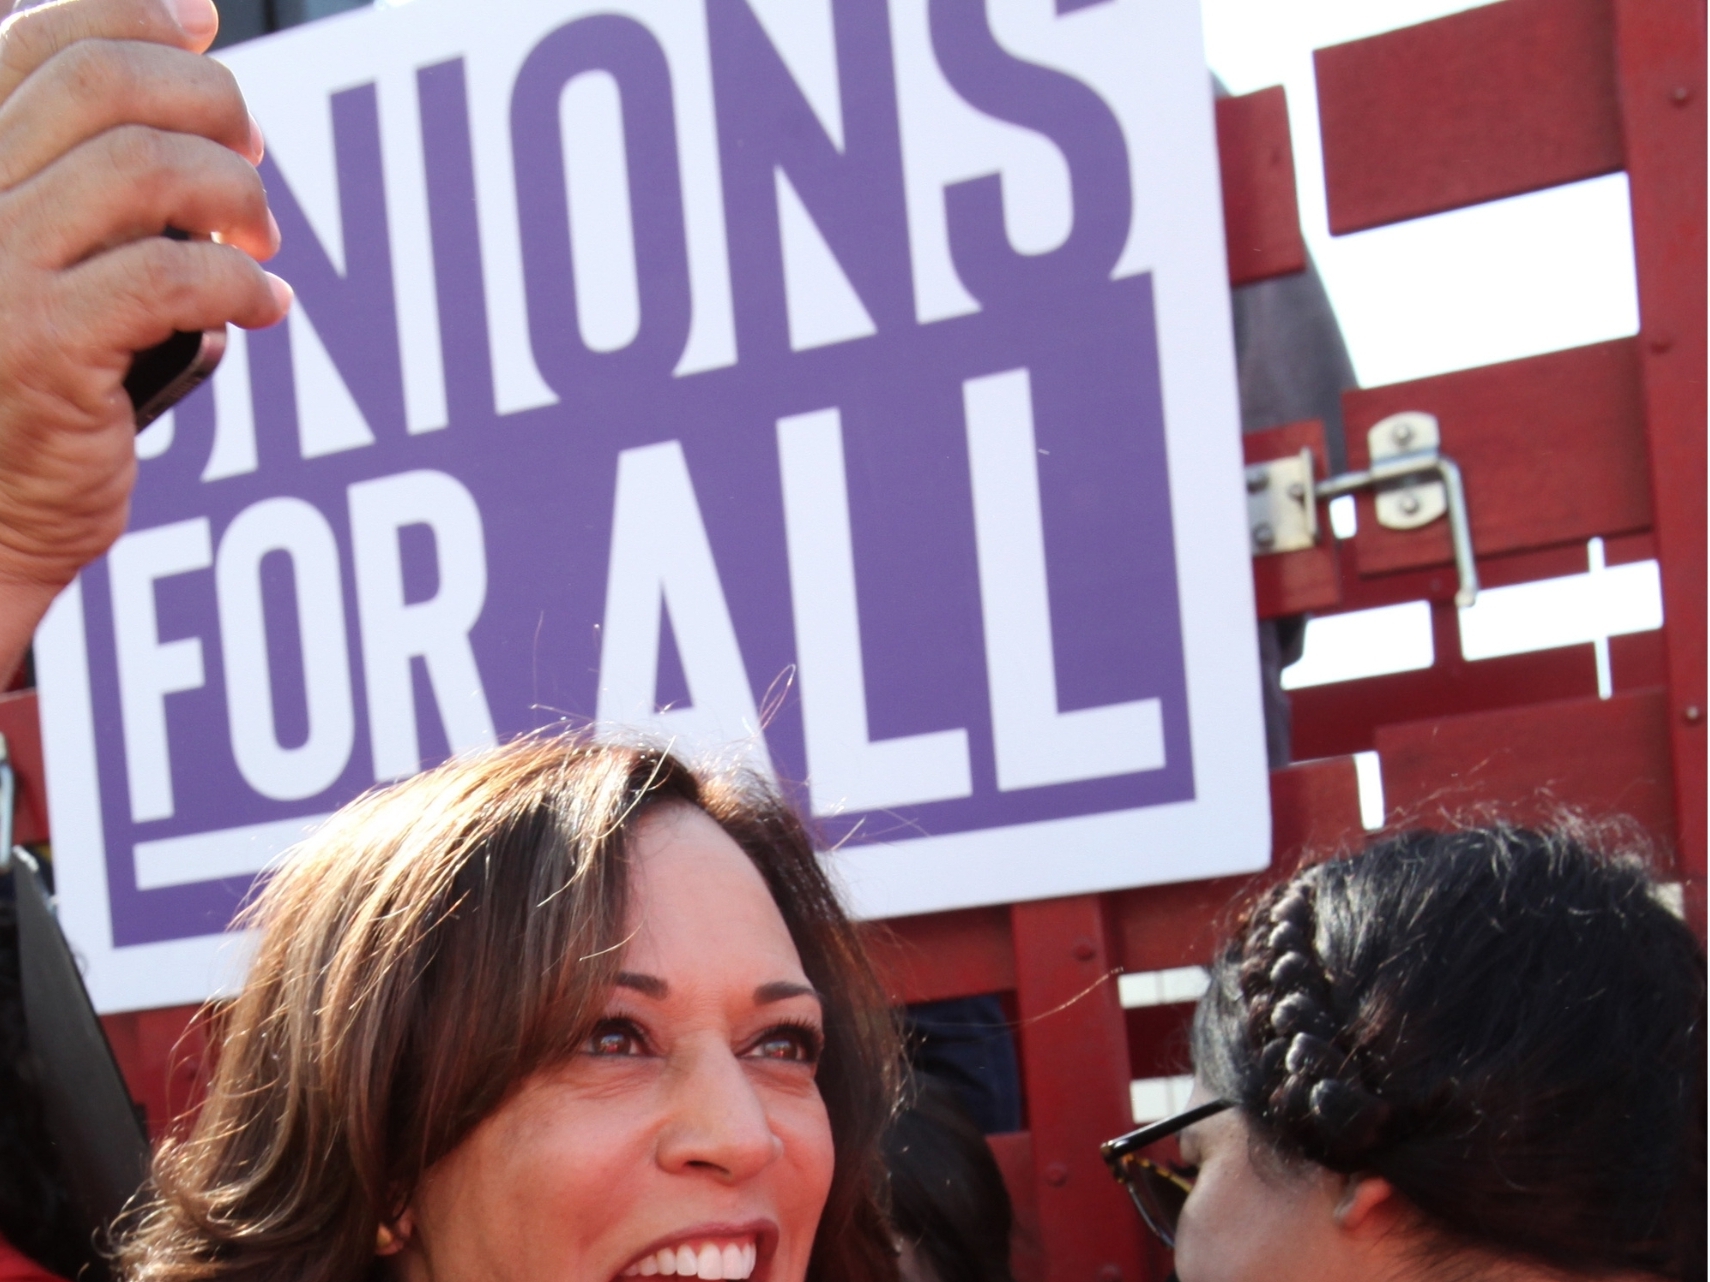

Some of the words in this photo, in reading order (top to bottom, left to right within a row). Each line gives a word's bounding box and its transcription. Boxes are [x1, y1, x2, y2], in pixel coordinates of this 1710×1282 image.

[133, 0, 1134, 484] NIONS
[109, 468, 498, 823] FOR
[597, 367, 1166, 817] ALL
